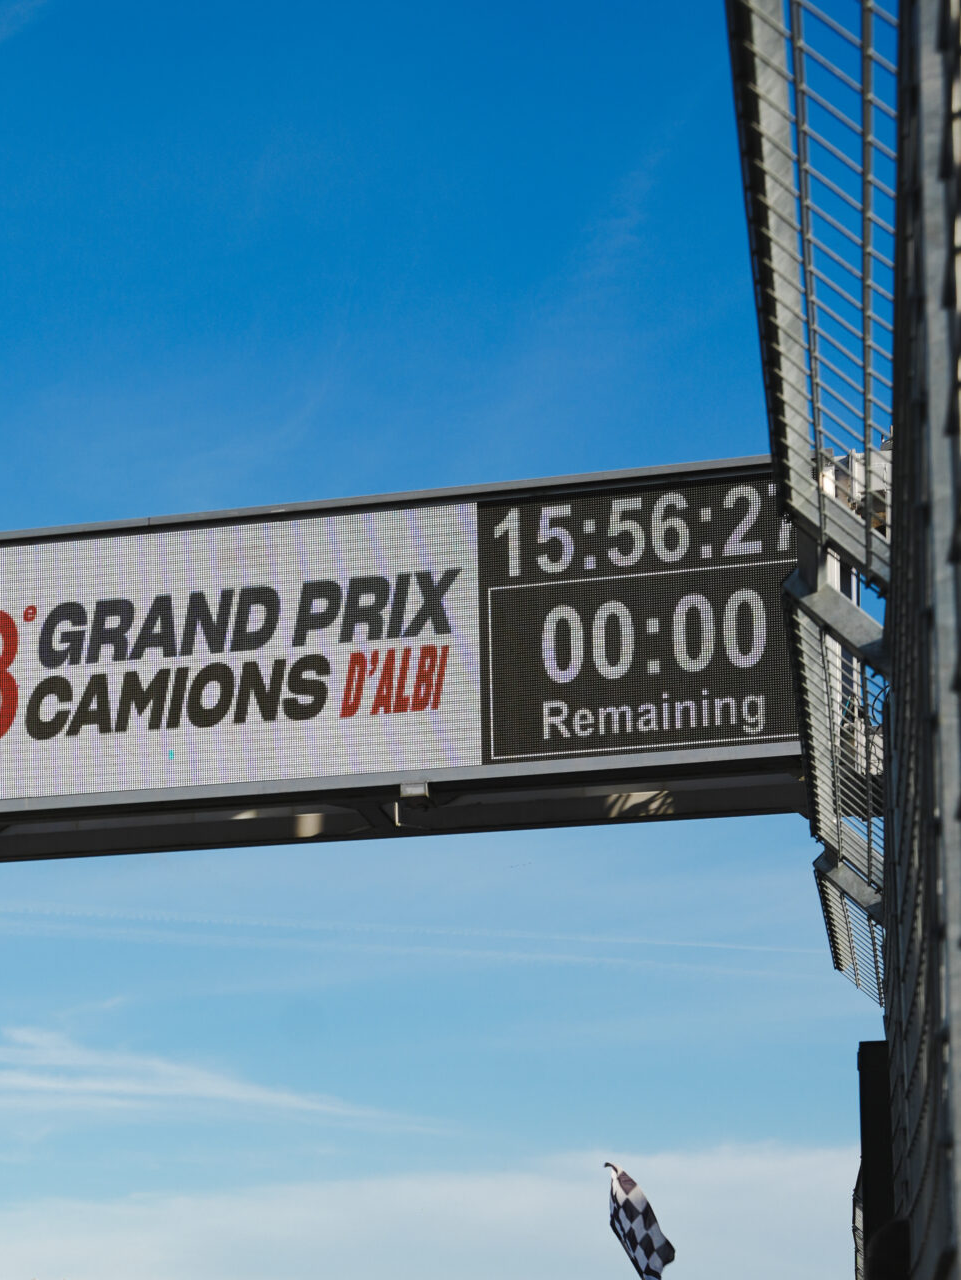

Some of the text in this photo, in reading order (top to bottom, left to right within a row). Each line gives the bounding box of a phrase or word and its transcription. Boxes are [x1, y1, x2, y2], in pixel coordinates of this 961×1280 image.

[38, 585, 281, 670] GRAND
[291, 568, 463, 648] PRIX
[542, 588, 767, 683] 00:00
[24, 645, 450, 740] CAMIONS D'ALBI
[542, 689, 766, 740] Remaining
